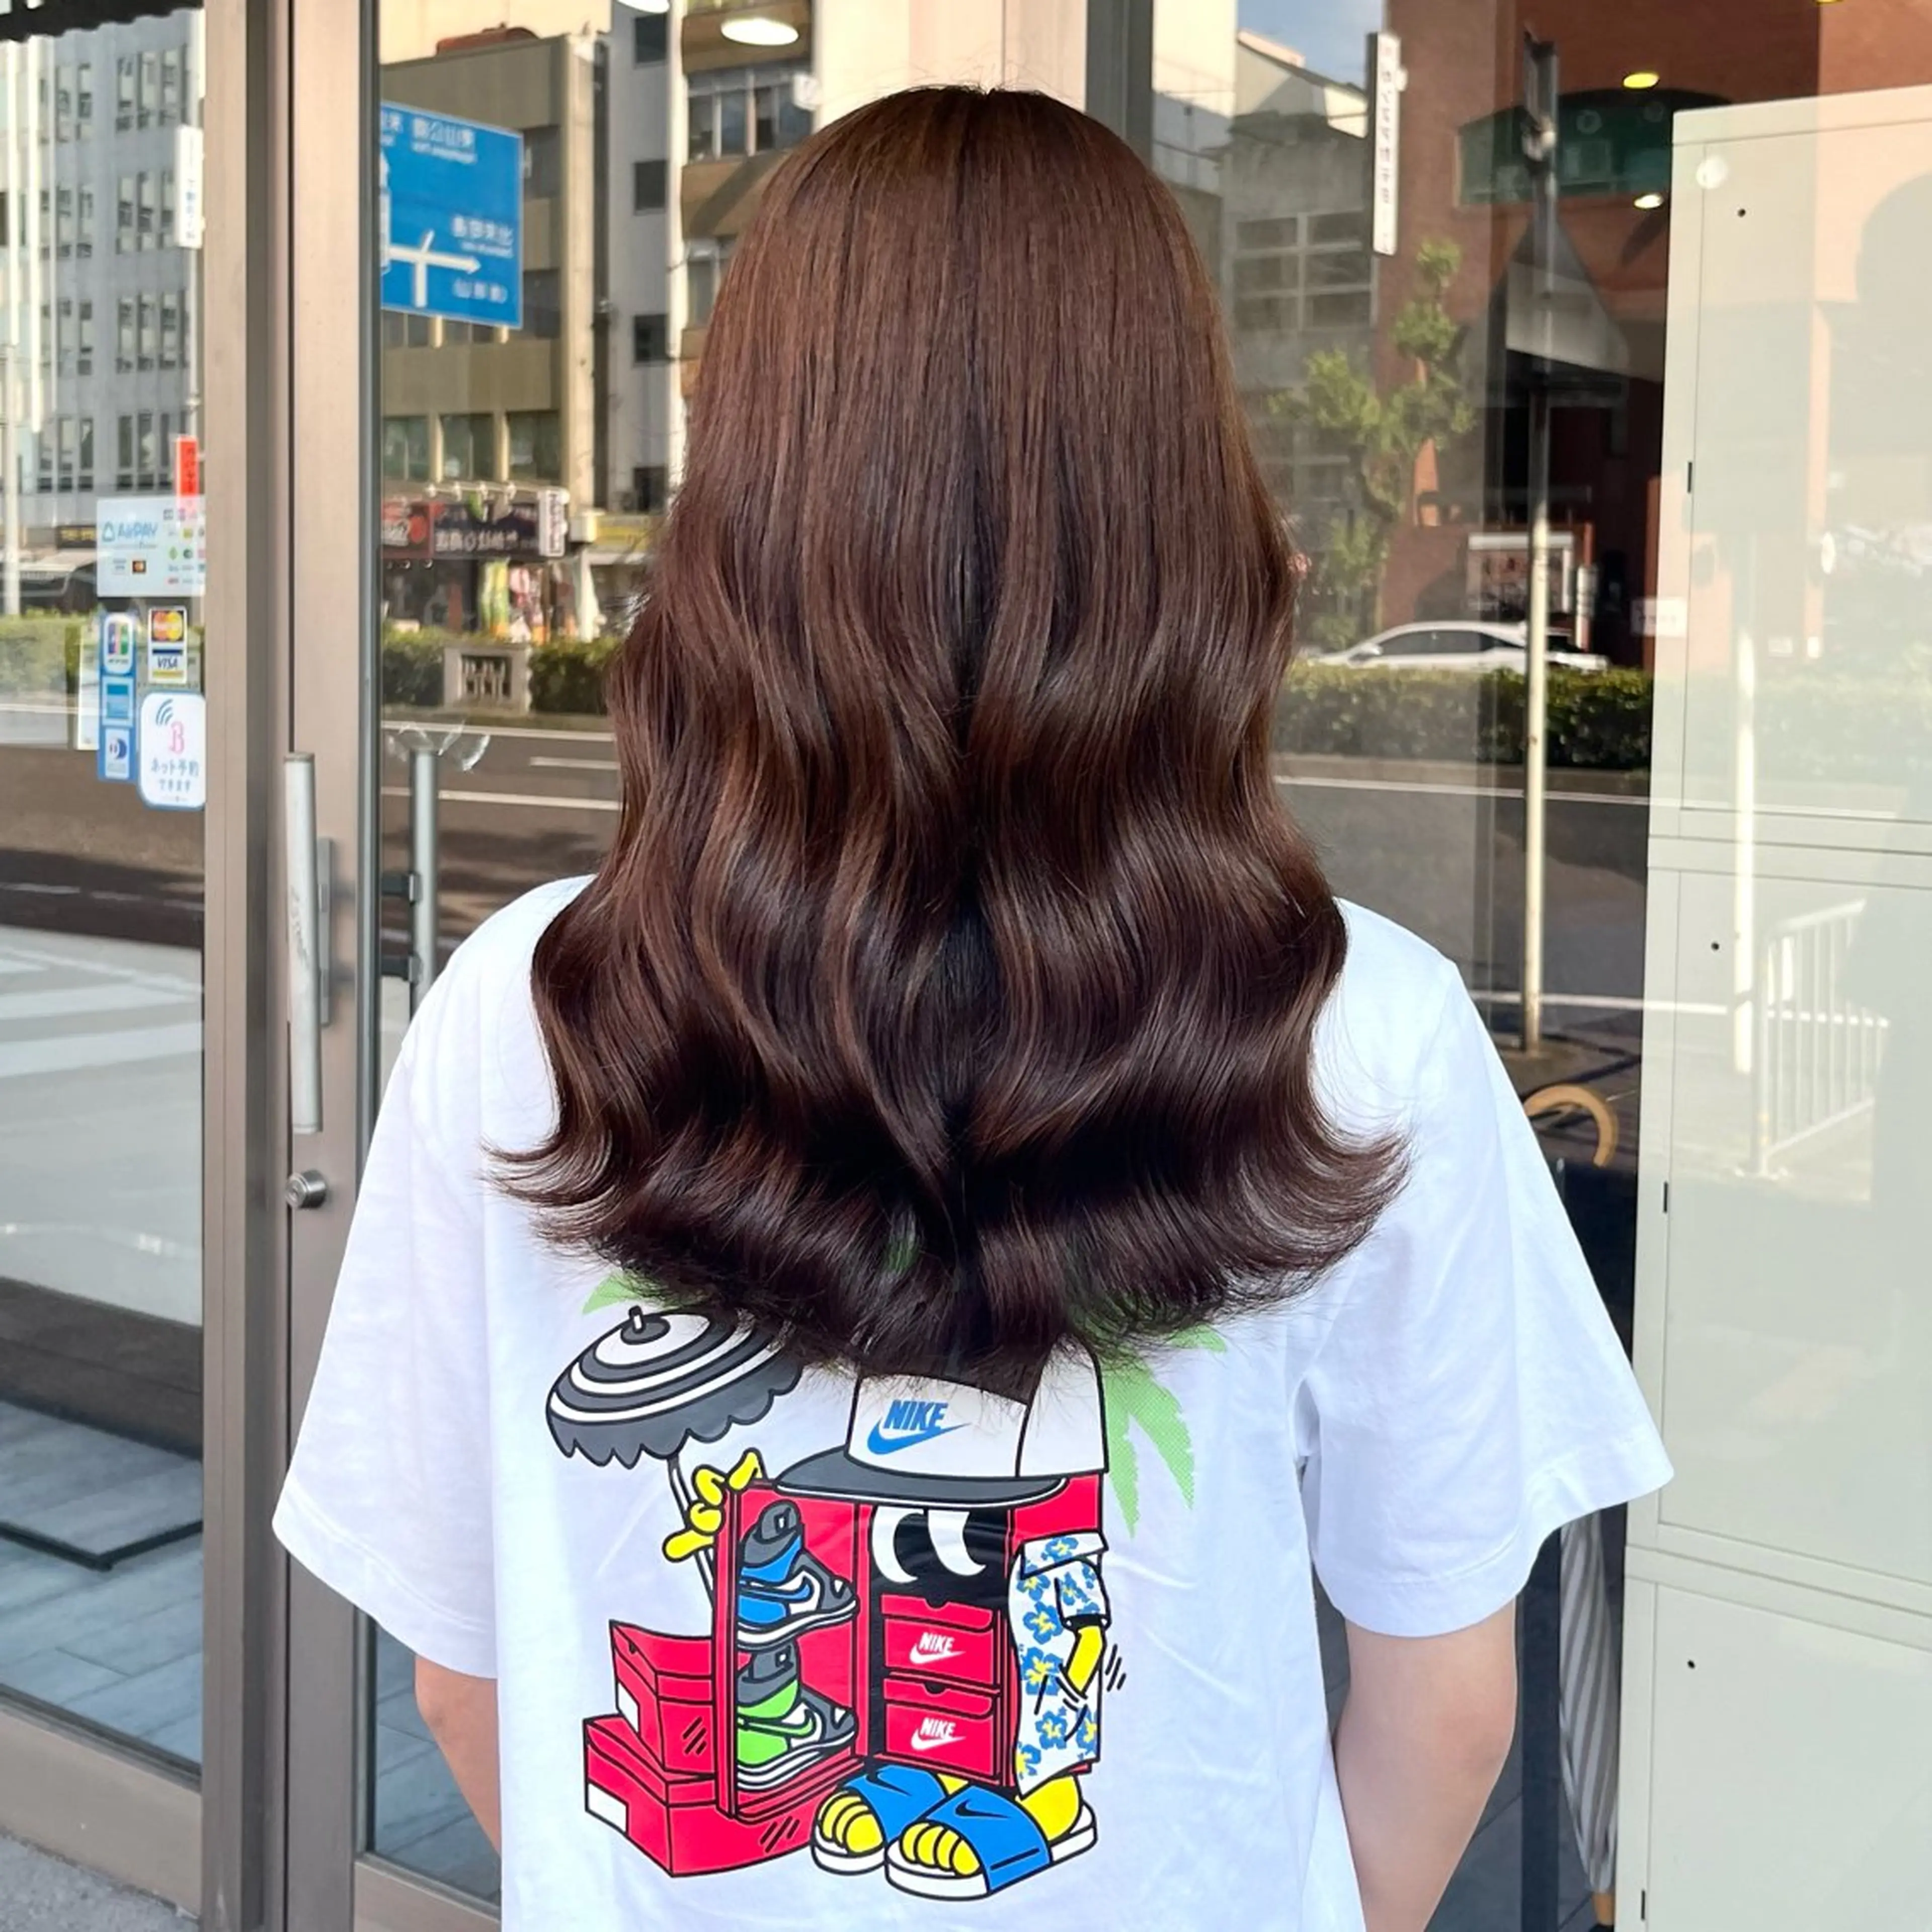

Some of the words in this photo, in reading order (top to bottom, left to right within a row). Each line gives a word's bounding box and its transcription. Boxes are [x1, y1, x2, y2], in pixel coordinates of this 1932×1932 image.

[157, 658, 178, 669] VISA
[883, 1399, 948, 1431] NIKE
[919, 1632, 955, 1652] NIKE
[920, 1717, 956, 1737] NIKE
